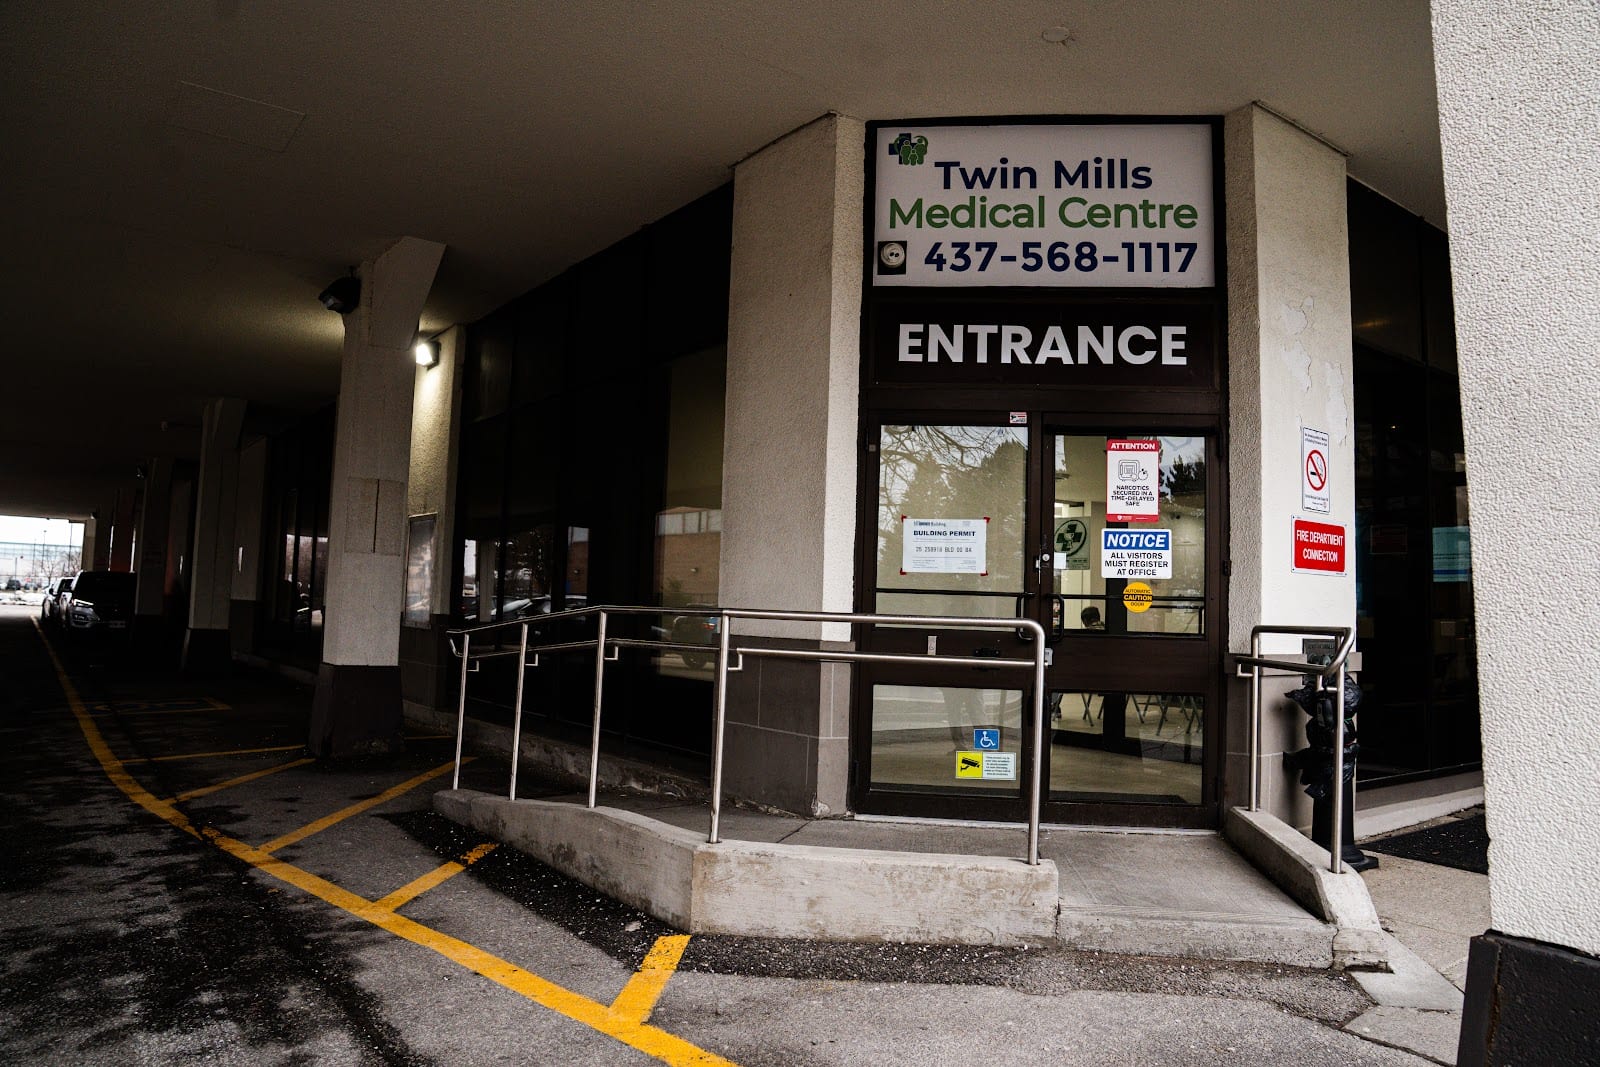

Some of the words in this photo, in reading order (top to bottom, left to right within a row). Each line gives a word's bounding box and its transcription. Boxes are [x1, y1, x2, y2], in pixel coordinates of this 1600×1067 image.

[934, 157, 1037, 190] Twin
[1054, 156, 1153, 189] Mills
[889, 195, 1045, 229] Medical
[1058, 196, 1198, 229] Centre
[924, 241, 1198, 273] 437-568-1117
[898, 323, 1188, 366] ENTRANCE
[1110, 442, 1156, 450] ATTENTION
[1106, 533, 1167, 548] NOTICE
[1296, 529, 1309, 542] FIRE
[1309, 531, 1344, 547] DEPARTMENT
[1127, 552, 1163, 560] VISITORS
[1302, 547, 1338, 563] CONNECTION
[1104, 560, 1127, 568] MUST
[1129, 560, 1169, 568] REGISTER
[1116, 568, 1127, 576] AT
[1128, 568, 1157, 576] OFFICE
